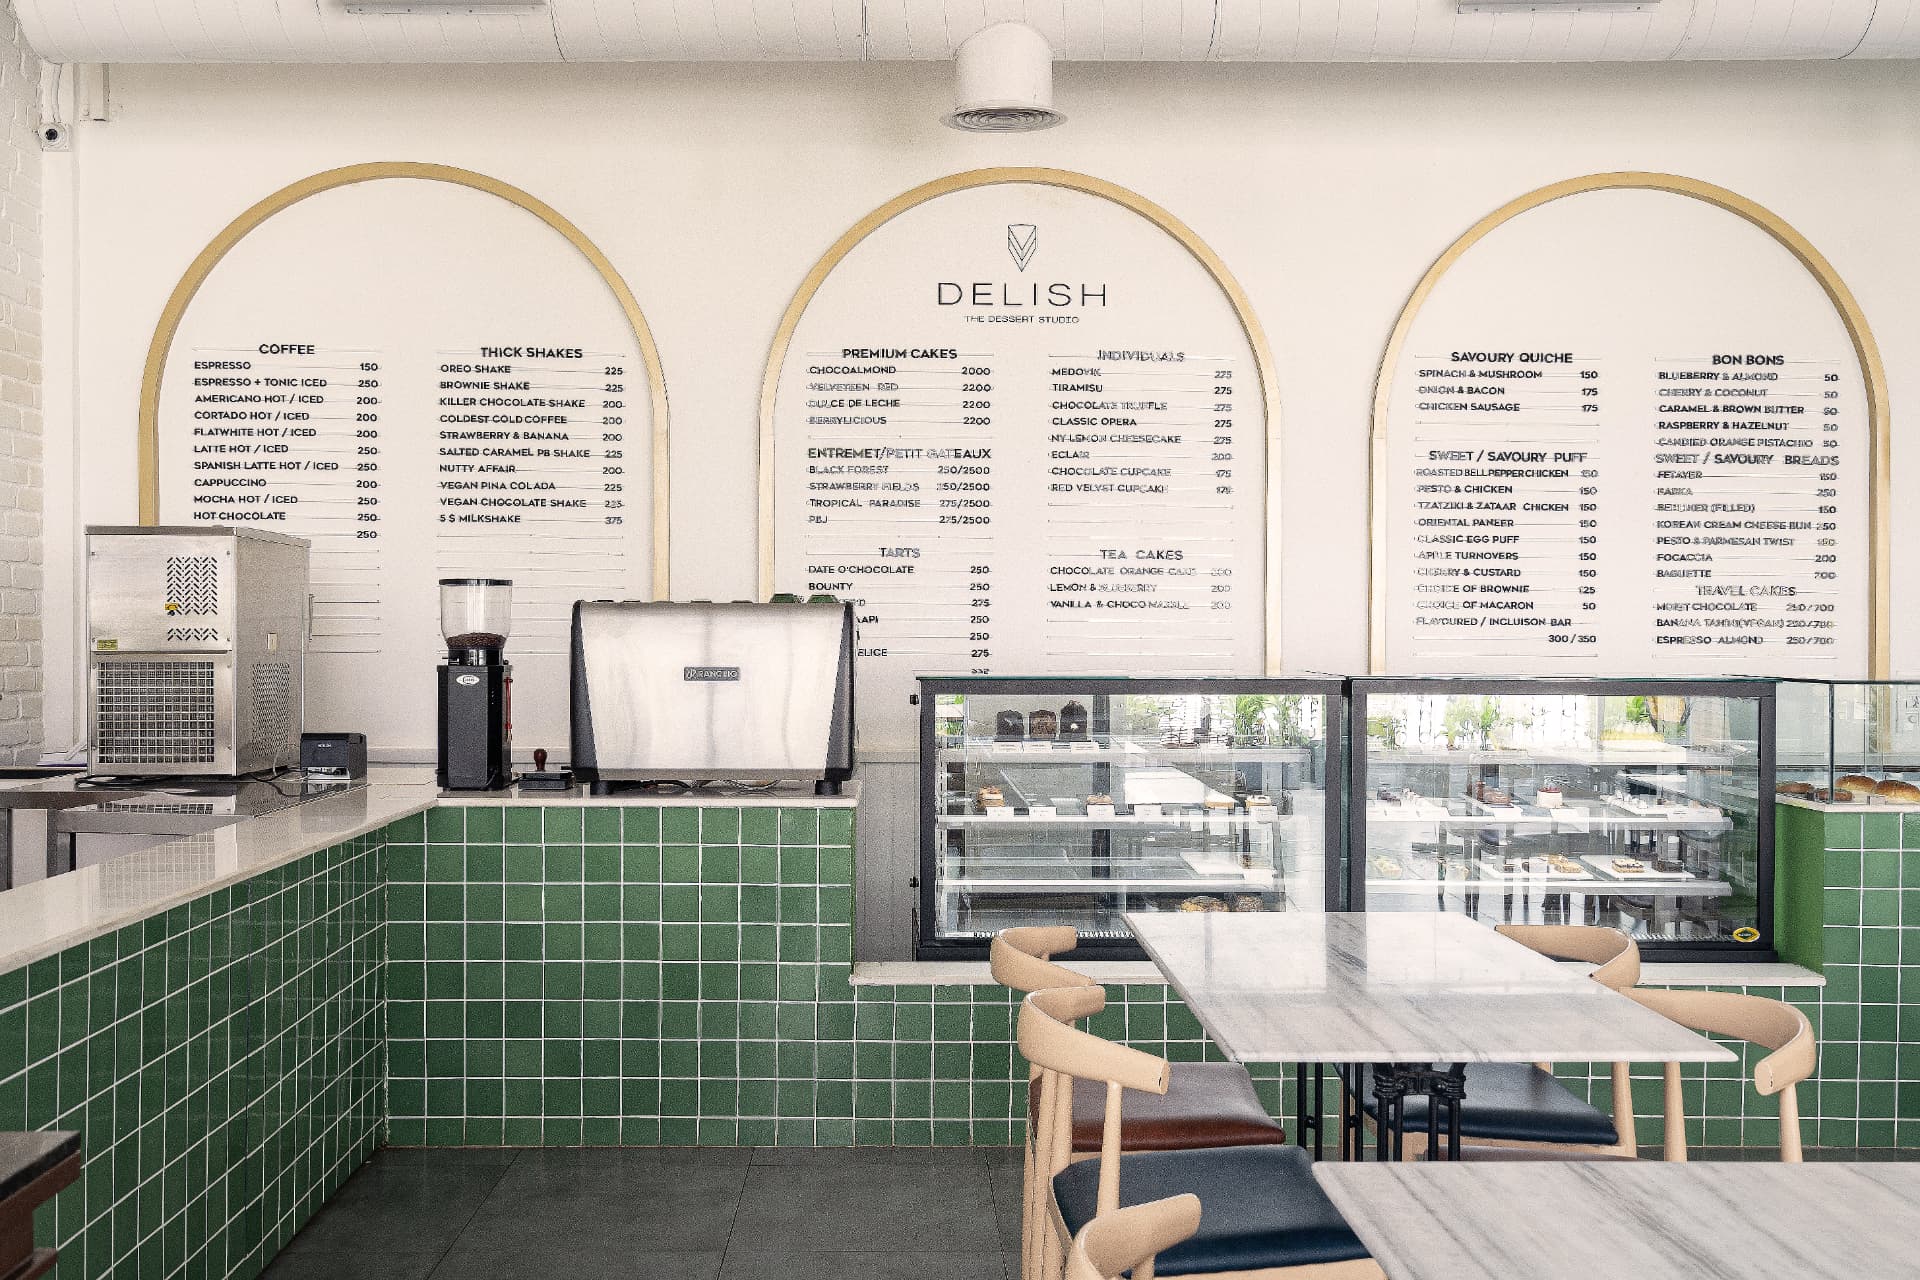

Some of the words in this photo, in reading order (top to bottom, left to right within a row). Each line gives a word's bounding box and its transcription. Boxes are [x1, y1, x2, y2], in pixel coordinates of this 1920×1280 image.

[938, 283, 1106, 307] DELISH
[259, 344, 315, 354] COFFEE
[481, 347, 522, 357] THICK
[527, 348, 583, 358] SHAKES
[843, 349, 907, 358] PREMIUM
[911, 349, 957, 359] CAKES
[1451, 352, 1514, 362] SAVOURY
[1520, 353, 1573, 363] QUICHE
[1713, 355, 1742, 364] BON
[1746, 355, 1784, 365] BONS
[360, 363, 378, 371] 150
[441, 365, 472, 373] OREO
[475, 365, 511, 373] SHAKE
[605, 367, 623, 375] 225
[810, 366, 896, 374] CHOCOALMOND
[962, 367, 990, 375] 2000
[1580, 371, 1598, 379] 150
[301, 379, 327, 387] ICED
[494, 382, 530, 390] SHAKE
[606, 384, 623, 392] 225
[962, 384, 991, 392] 2200
[1052, 384, 1102, 392] TIRAMISU
[1215, 387, 1232, 395] 275
[1467, 387, 1505, 395] BACON
[1582, 388, 1598, 396] 175
[195, 395, 261, 403] AMERICANO
[264, 395, 285, 403] HOT
[290, 394, 295, 403] /
[357, 397, 377, 405] 200
[440, 398, 476, 406] KILLER
[479, 398, 546, 407] CHOCOLATE
[549, 399, 585, 407] SHAKE
[1659, 405, 1709, 413] CARAMEL
[1764, 406, 1804, 414] BUTTER
[194, 412, 247, 420] CORTADO
[250, 412, 272, 420] HOT
[275, 411, 280, 420] /
[440, 415, 489, 423] COLDEST
[493, 416, 522, 424] COLD
[525, 416, 567, 424] COFFEE
[602, 417, 622, 425] 200
[963, 417, 990, 425] 2200
[1052, 418, 1097, 426] CLASSIC
[1101, 418, 1136, 426] OPERA
[1215, 420, 1232, 428] 275
[1733, 422, 1789, 430] HAZELNUT
[194, 428, 254, 436] FLATWHITE
[282, 428, 288, 437] /
[356, 430, 377, 438] 200
[440, 431, 510, 439] STRAWBERRY
[523, 432, 568, 440] BANANA
[254, 444, 260, 453] /
[264, 445, 288, 453] ICED
[358, 447, 377, 455] 250
[440, 448, 479, 456] SALTED
[483, 448, 533, 457] CARAMEL
[538, 449, 550, 457] PB
[554, 450, 590, 458] SHAKE
[1429, 451, 1474, 461] SWEET
[1477, 450, 1484, 462] /
[1488, 452, 1546, 462] SAVOURY
[1554, 453, 1587, 462] PUFF
[194, 462, 241, 470] SPANISH
[244, 462, 276, 470] LATTE
[280, 462, 301, 470] HOT
[304, 461, 310, 470] /
[314, 462, 338, 470] ICED
[357, 463, 377, 471] 250
[478, 465, 516, 473] AFFAIR
[441, 482, 478, 490] VEGAN
[481, 482, 506, 490] PINA
[510, 482, 555, 490] COLADA
[264, 494, 270, 504] /
[357, 497, 377, 505] 250
[441, 498, 477, 506] VEGAN
[481, 498, 547, 507] CHOCOLATE
[550, 499, 587, 507] SHAKE
[605, 500, 621, 508] 225
[194, 512, 216, 520] HOT
[219, 512, 286, 520] CHOCOLATE
[1473, 519, 1514, 527] PANEER
[879, 548, 920, 558] TARTS
[1100, 550, 1126, 559] TEA
[1136, 550, 1183, 560] CAKES
[970, 566, 989, 574] 250
[972, 599, 990, 607] 275
[1549, 635, 1568, 643] 300
[1578, 635, 1596, 643] 350
